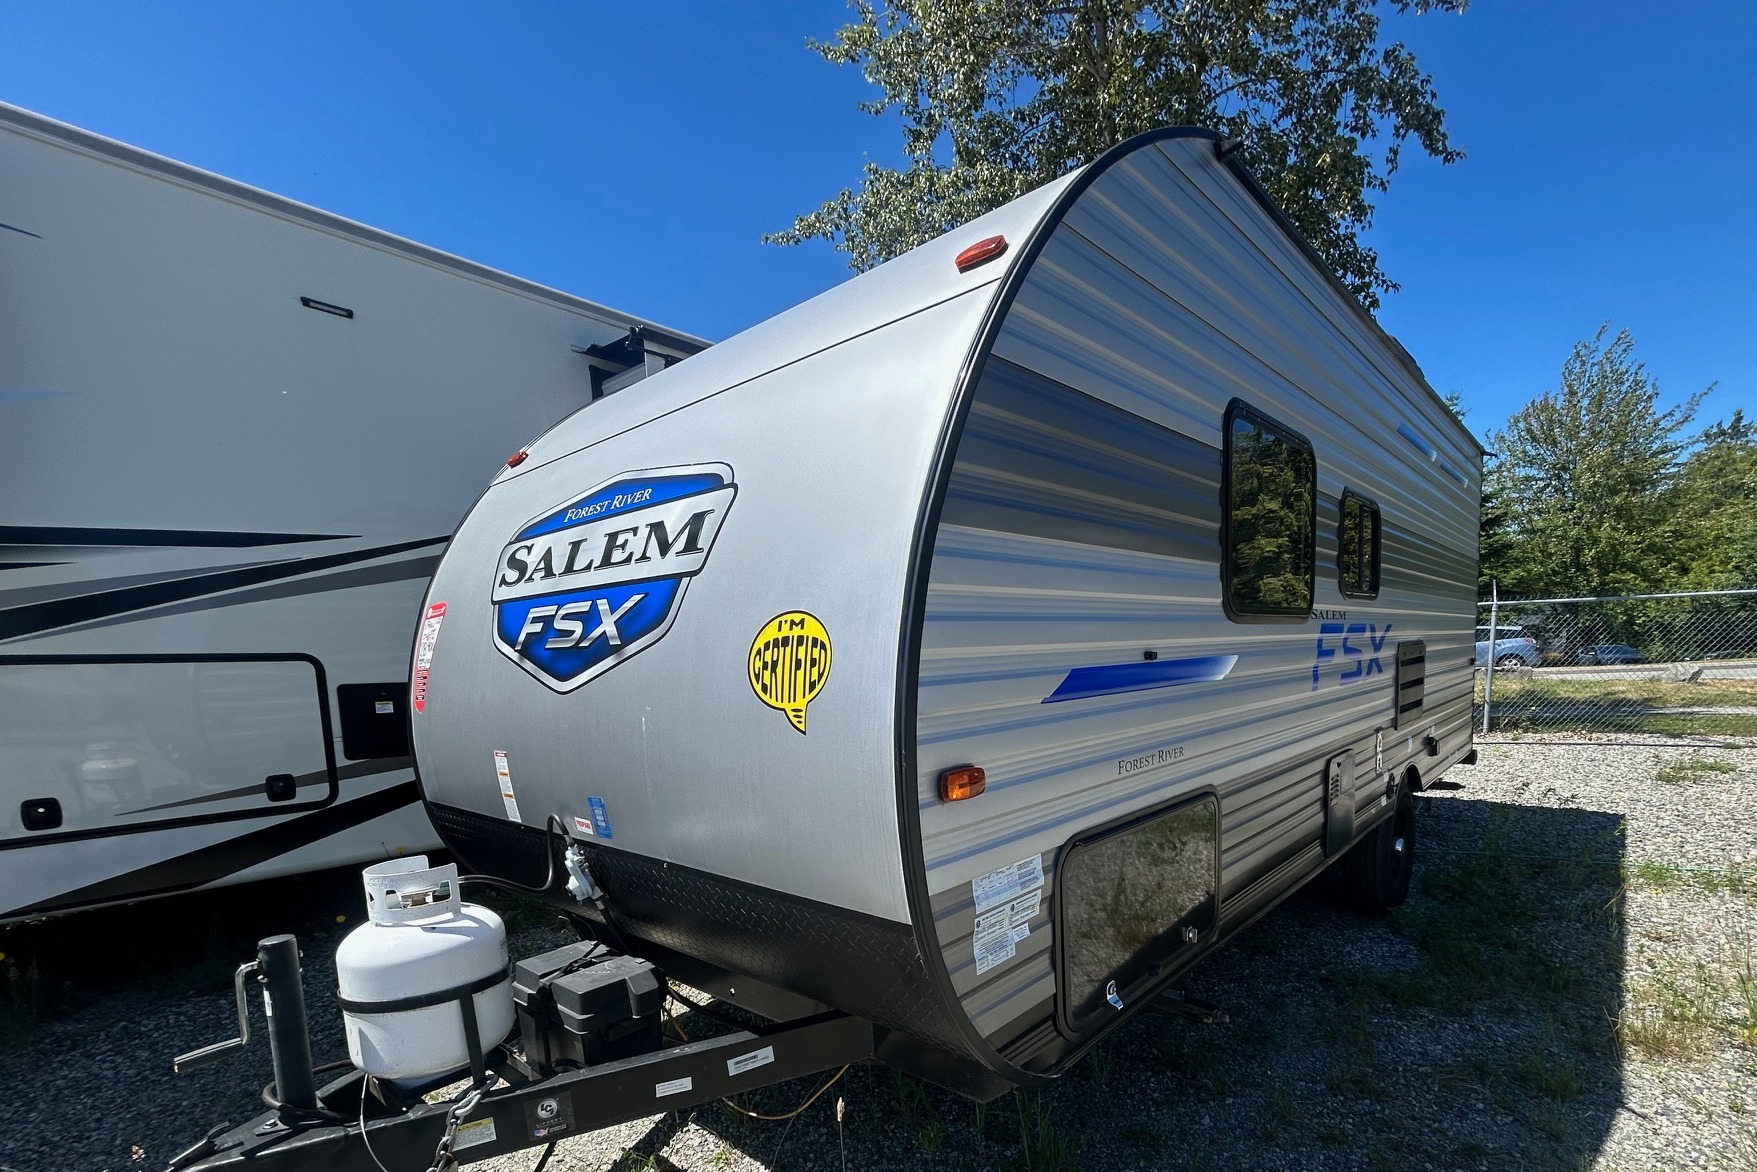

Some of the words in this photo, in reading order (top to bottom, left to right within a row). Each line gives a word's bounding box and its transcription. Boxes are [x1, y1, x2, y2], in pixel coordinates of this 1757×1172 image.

[564, 500, 610, 522] FOREST
[611, 488, 652, 510] RIVER
[499, 509, 715, 588] SALEM
[514, 593, 648, 652] FSX
[777, 618, 805, 632] I'M
[1311, 609, 1346, 620] SALEM
[753, 635, 828, 704] CERTIFIED
[1311, 623, 1393, 692] FSX
[1118, 753, 1156, 775] FOREST
[1157, 746, 1184, 764] RIVER
